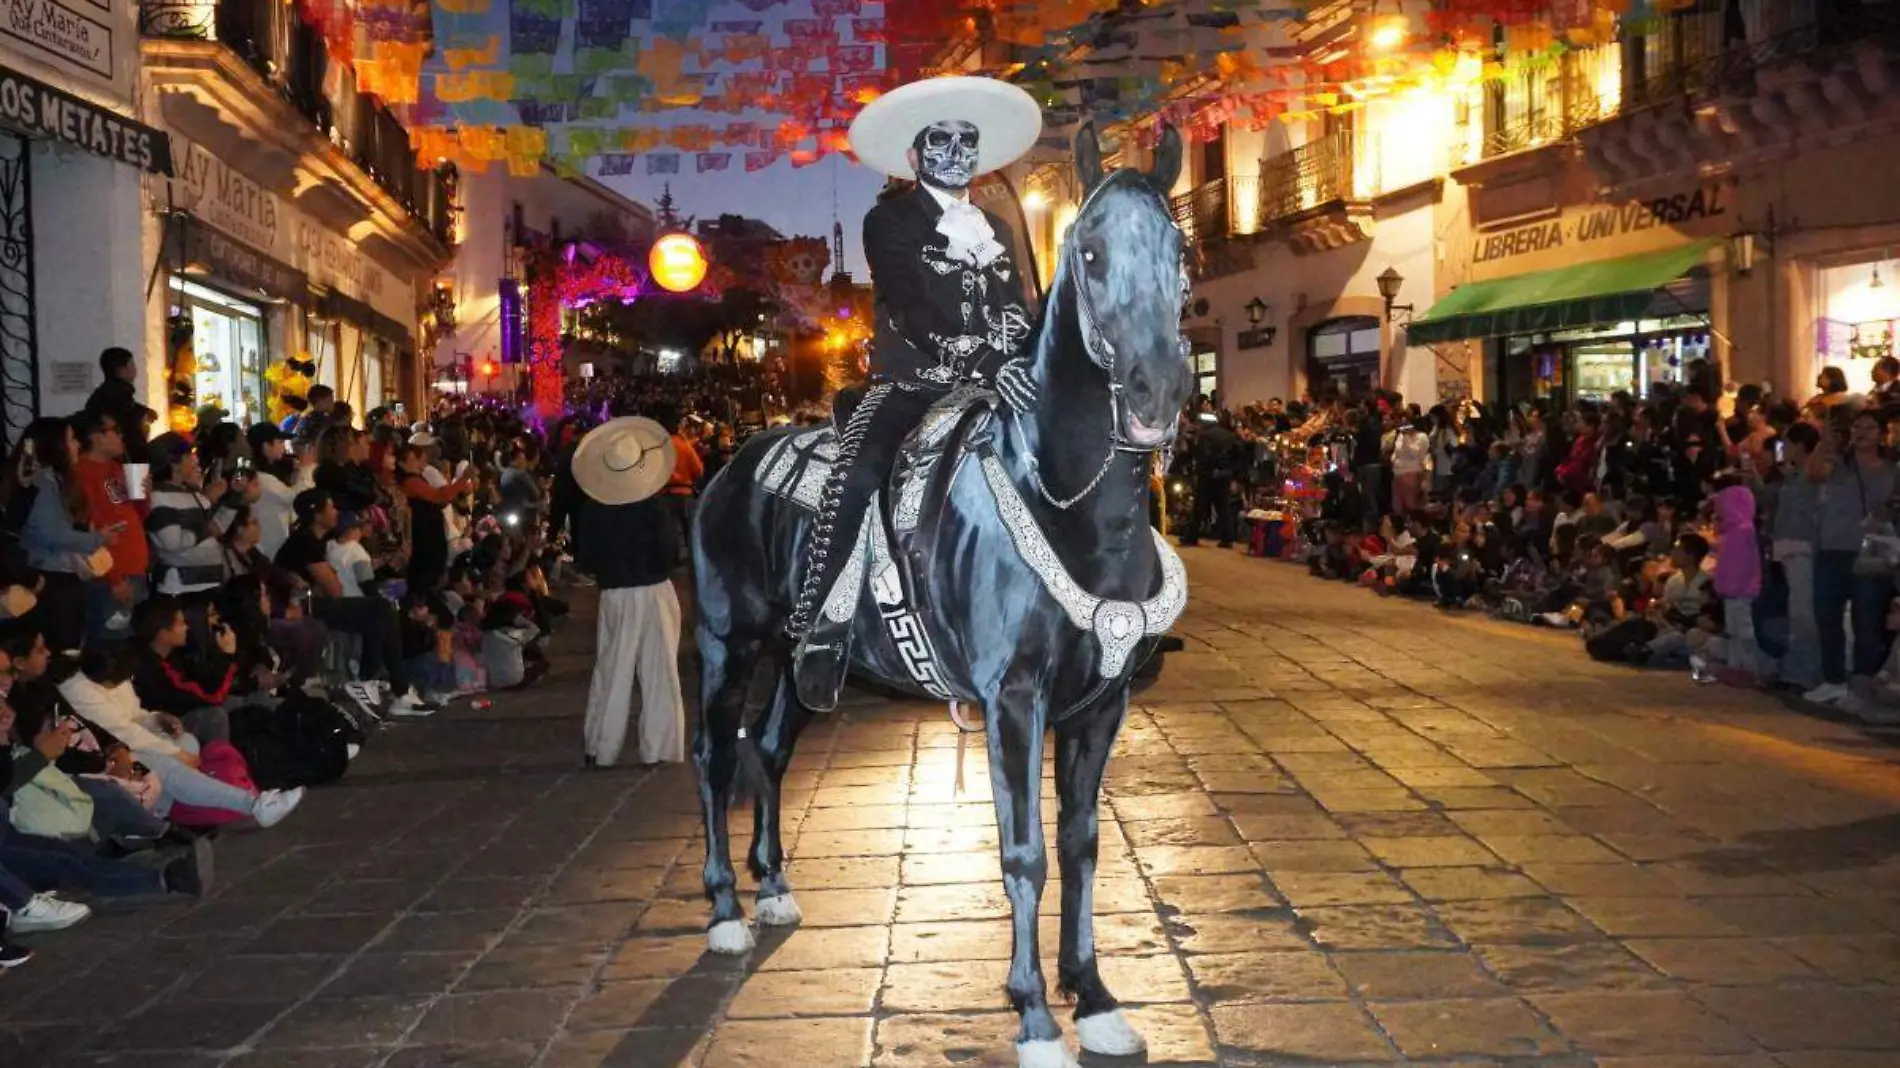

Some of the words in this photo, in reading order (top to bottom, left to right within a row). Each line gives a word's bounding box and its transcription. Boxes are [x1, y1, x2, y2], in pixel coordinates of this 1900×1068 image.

[0, 77, 35, 125] OS
[41, 90, 152, 168] METATES
[1577, 186, 1726, 242] UNIVERSAL
